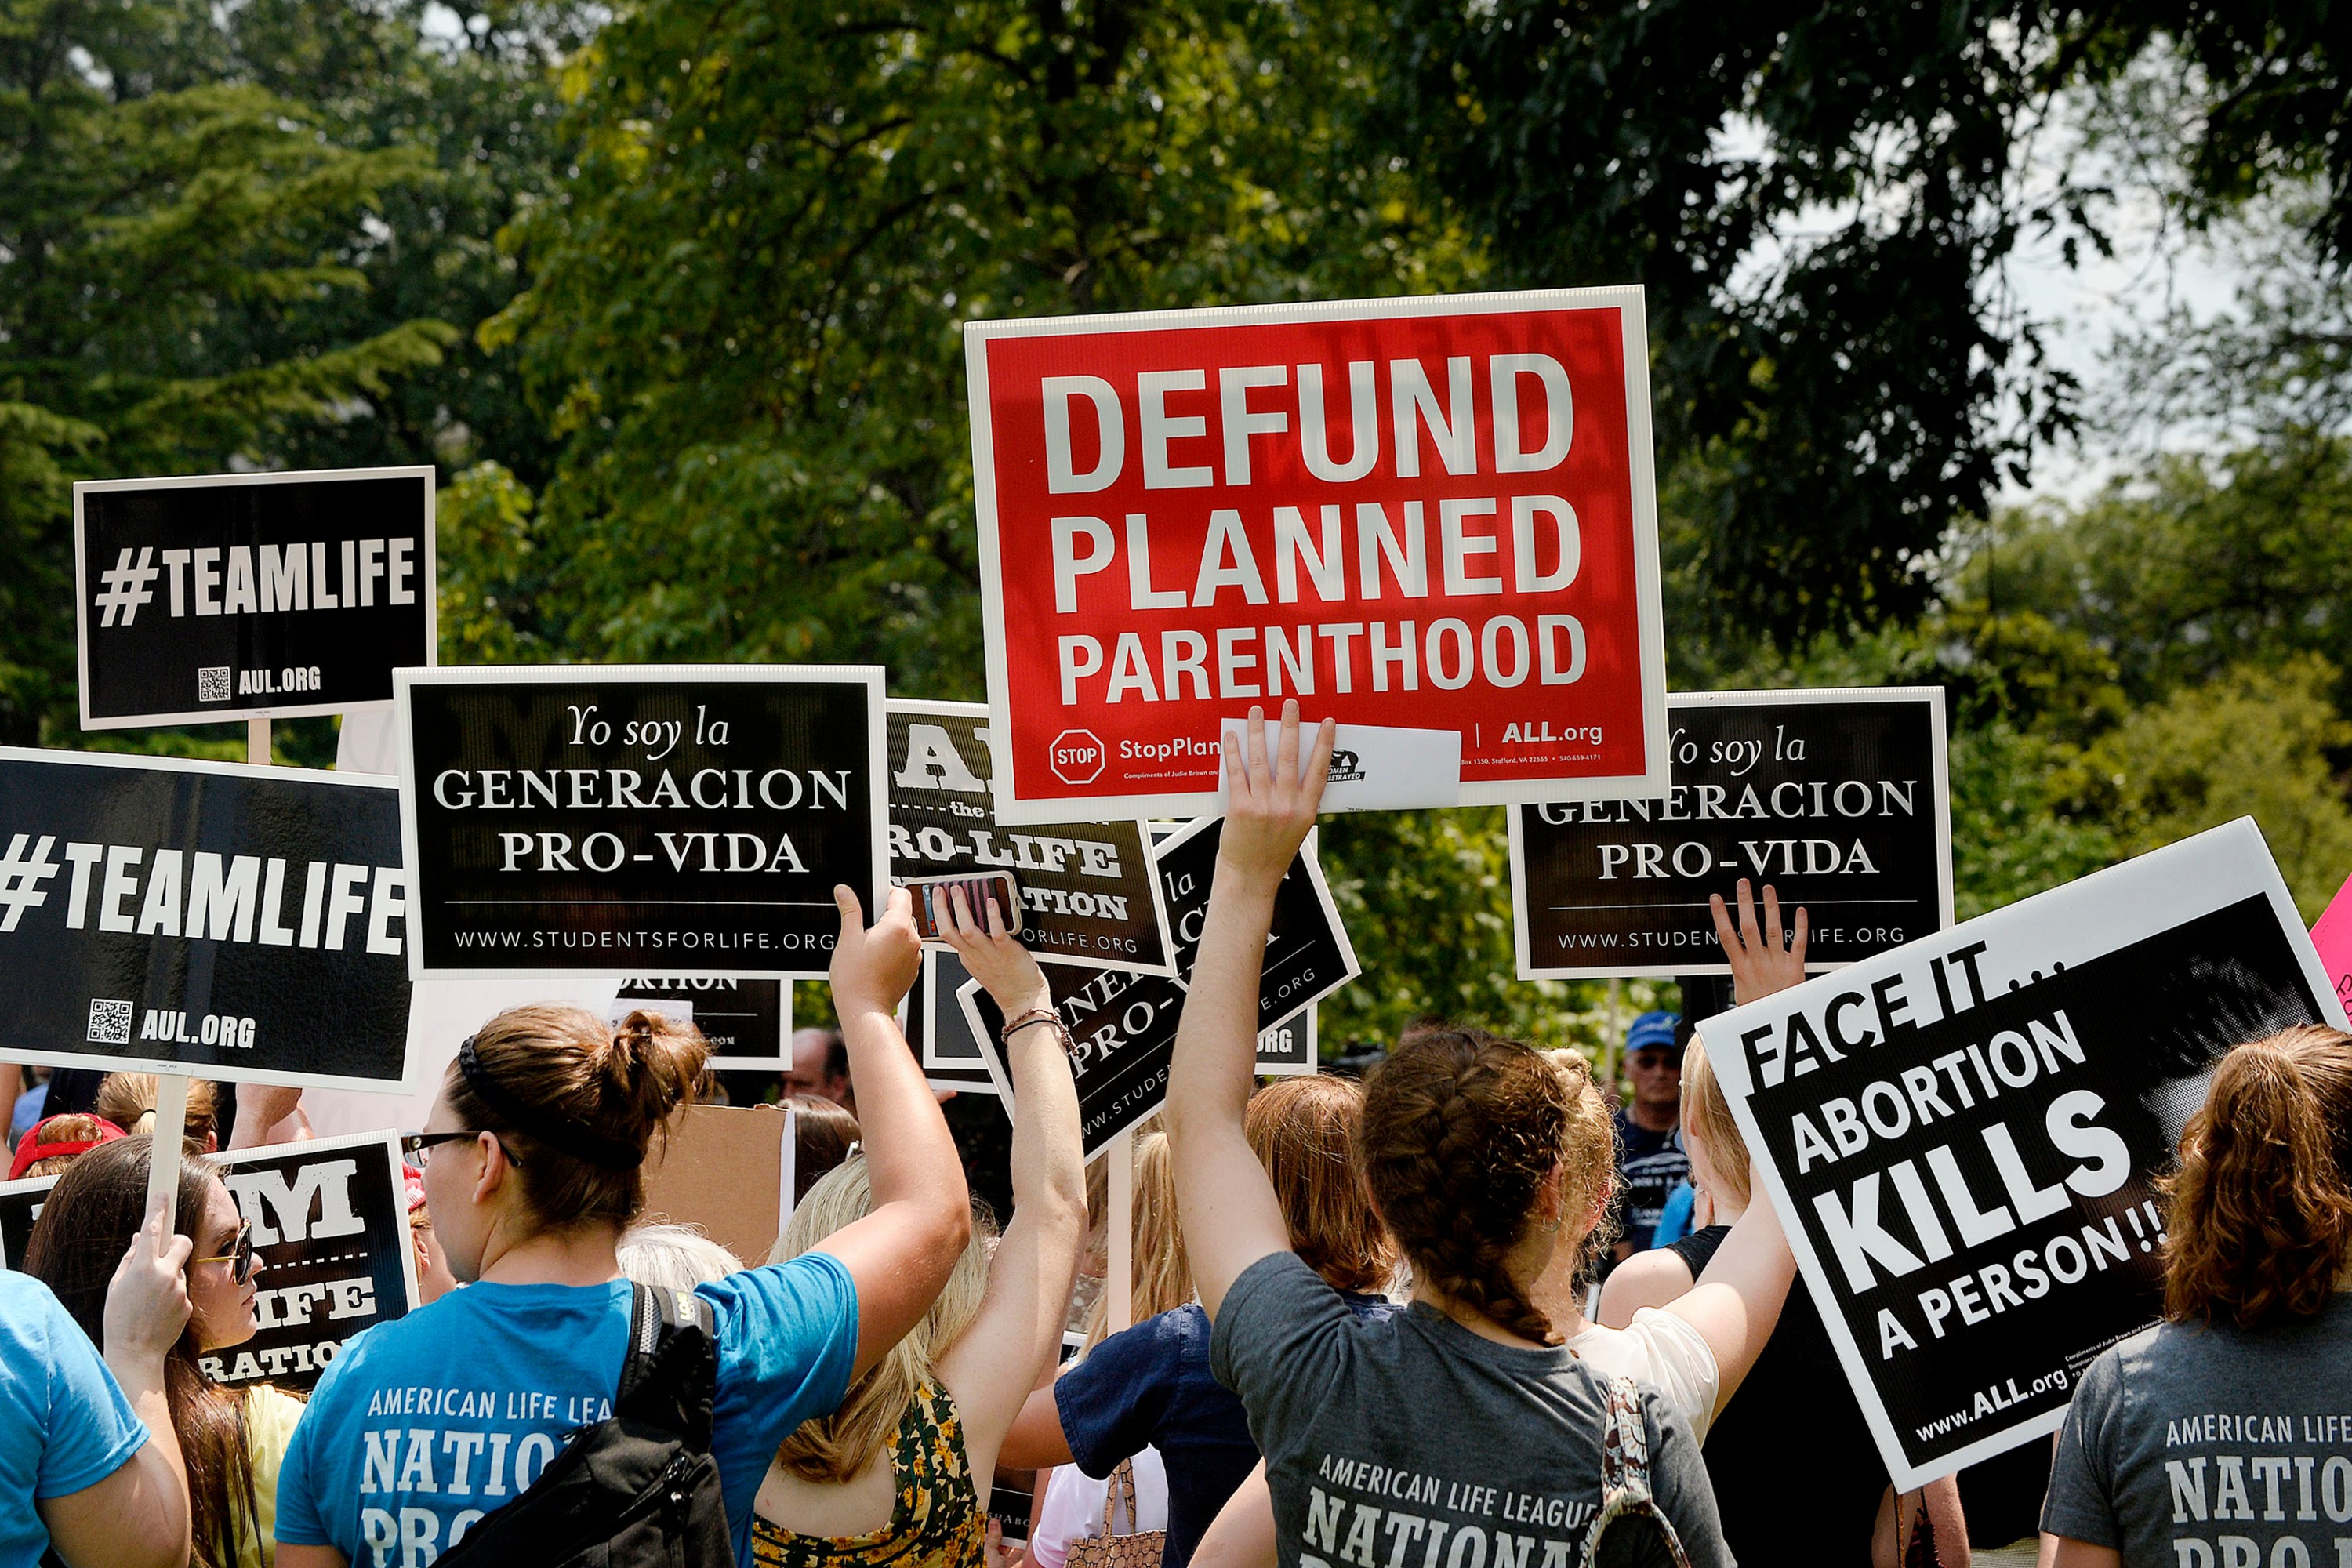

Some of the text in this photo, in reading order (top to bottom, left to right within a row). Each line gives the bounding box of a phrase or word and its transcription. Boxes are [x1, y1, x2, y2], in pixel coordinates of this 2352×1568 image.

[1040, 353, 1575, 495] DEFUND
[1050, 495, 1582, 615] PLANNED
[94, 537, 415, 627] #TEAMLIFE
[238, 666, 321, 695] AUL.ORG
[1058, 614, 1587, 706] PARENTHOOD
[568, 704, 730, 760] Yo soy la
[1058, 746, 1098, 765] STOP
[1120, 720, 1603, 763] StopPlan ALL.org
[1709, 739, 1762, 776] soy
[1775, 725, 1806, 761] la
[433, 768, 851, 811] GENERACION
[949, 800, 985, 818] the
[498, 831, 810, 873] PRO-VIDA
[890, 823, 1123, 878] RO-LIFE
[1596, 837, 1881, 880] PRO-VIDA
[0, 833, 405, 956] #TEAMLIFE
[1165, 870, 1196, 902] la
[454, 930, 836, 951] WWW.STUDENTSFORLIFE.ORG
[1022, 927, 1138, 954] ORLIFE.ORG
[140, 1008, 256, 1049] AUL.ORG
[1740, 972, 1910, 1097] FACE
[1791, 1009, 2087, 1175] ABORTION
[224, 1158, 366, 1248] M
[1811, 1089, 2132, 1295] KILLS
[252, 1276, 377, 1330] IFE
[1877, 1308, 1918, 1360] A
[198, 1339, 350, 1383] RATIO
[366, 1386, 612, 1425] AMERICAN LIFE LEA
[1915, 1368, 2069, 1442] www.ALL.org
[2165, 1413, 2352, 1448] AMERICAN LIFE
[360, 1428, 564, 1496] NATIO
[1319, 1453, 1442, 1506] AMERICAN
[1446, 1481, 1497, 1516] LIFE
[1301, 1486, 1587, 1568] NATIONA
